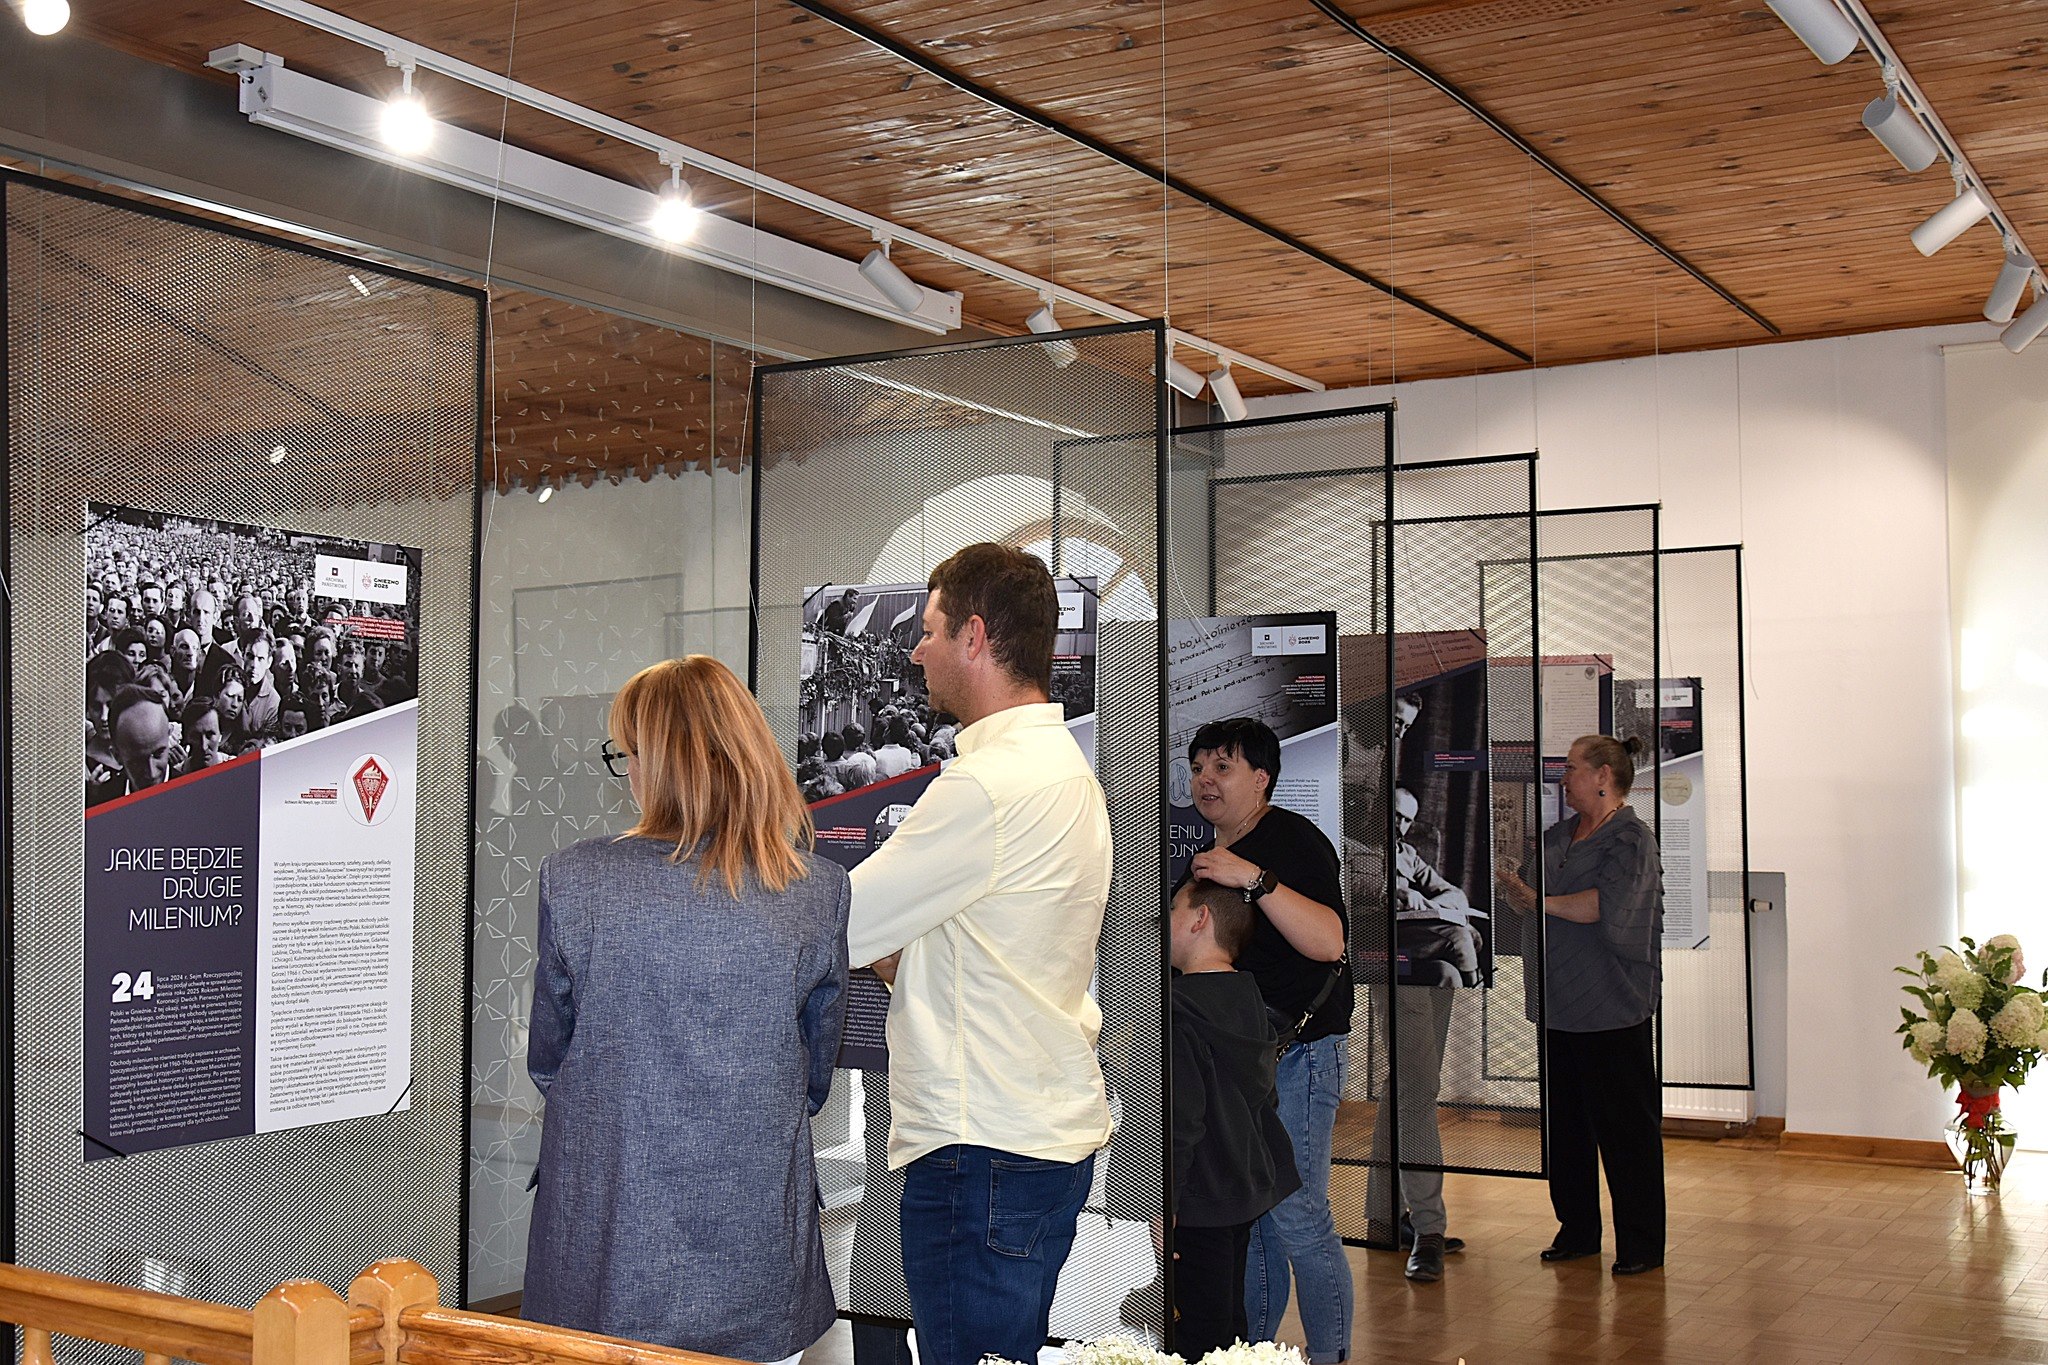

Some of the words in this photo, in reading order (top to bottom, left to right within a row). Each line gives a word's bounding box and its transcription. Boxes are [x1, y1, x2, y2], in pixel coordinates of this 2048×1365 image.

[373, 578, 400, 586] GNIEZNO
[105, 848, 164, 872] JAKIE
[170, 847, 243, 875] BĘDZIE
[163, 876, 242, 900] DRUGIE
[129, 905, 242, 931] MILENIUM?
[111, 970, 154, 1003] 24
